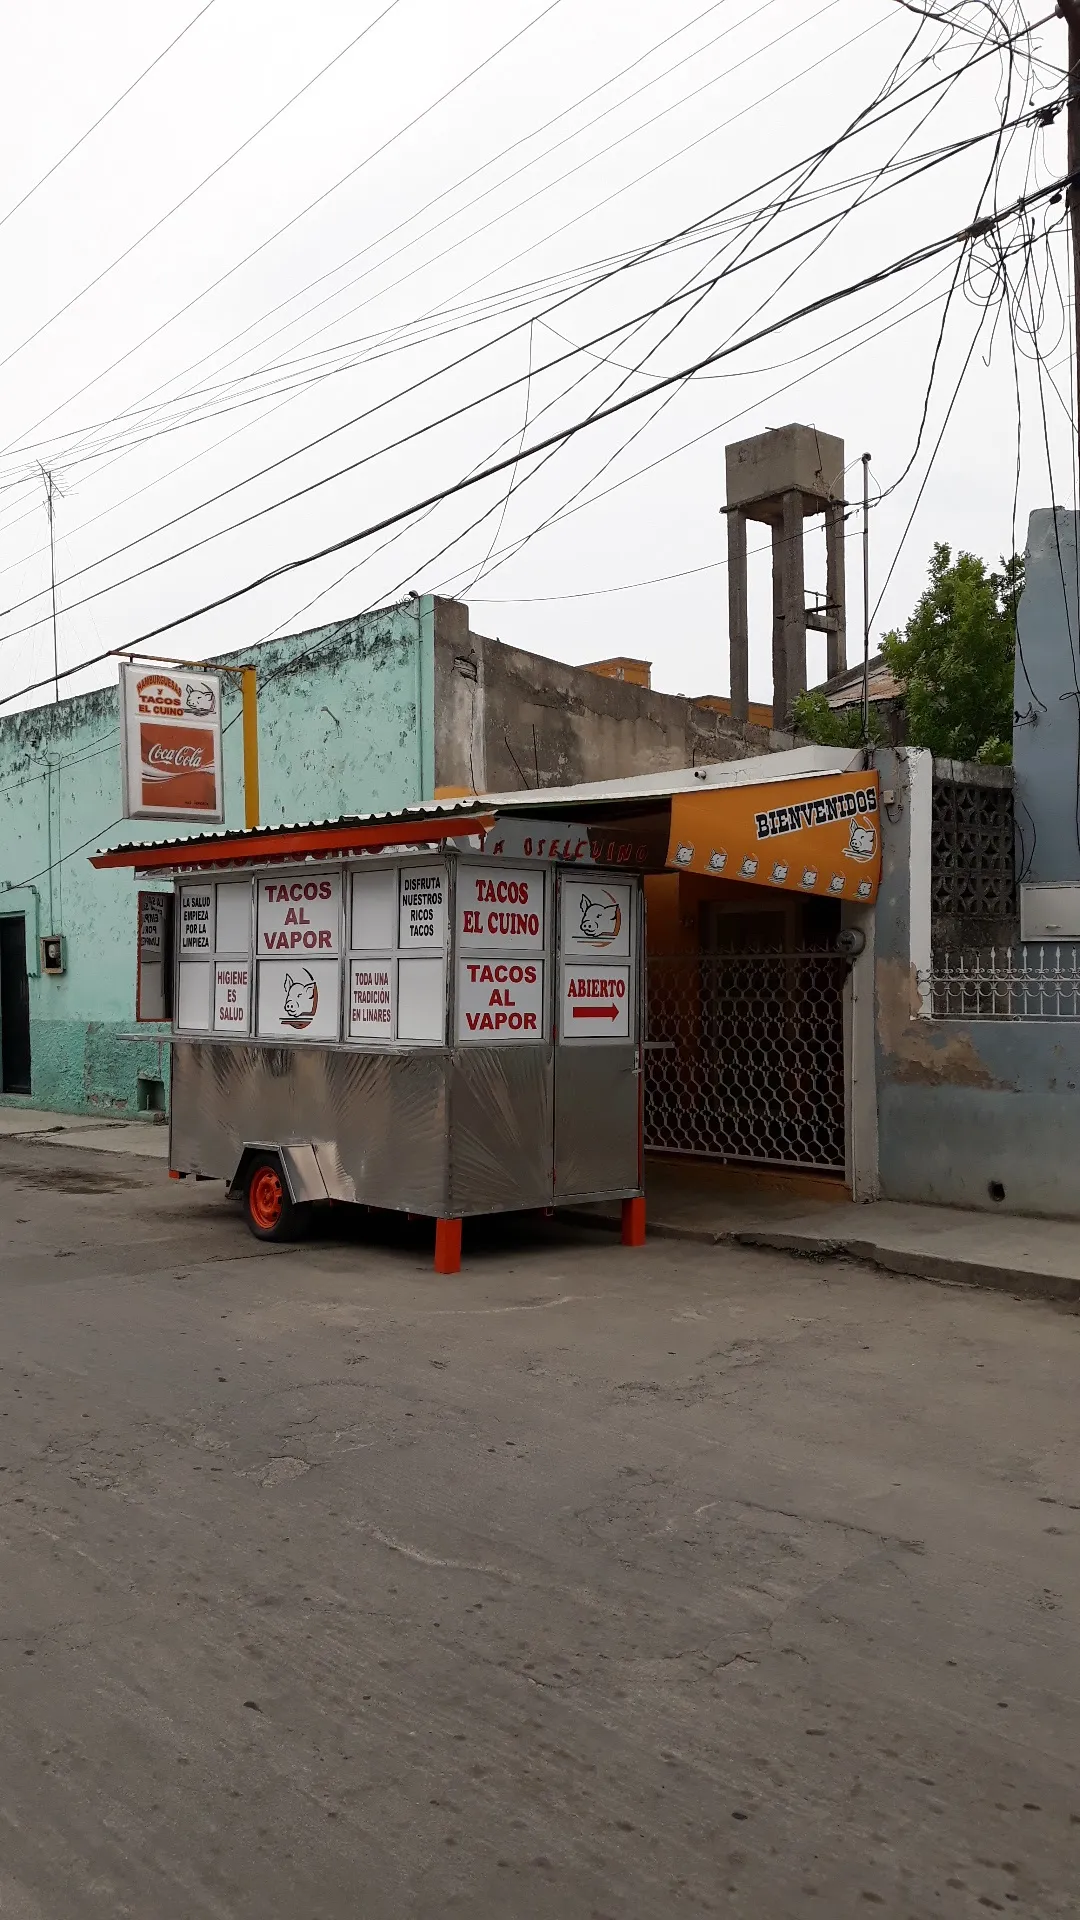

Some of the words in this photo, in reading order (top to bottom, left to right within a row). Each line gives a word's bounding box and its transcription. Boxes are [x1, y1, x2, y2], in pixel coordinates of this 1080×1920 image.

[136, 674, 182, 698] HAMBURGUESAS
[139, 695, 181, 706] TACOS
[138, 704, 151, 713] EL
[153, 706, 184, 716] CUINO
[755, 787, 877, 839] BIENVENIDOS
[404, 877, 441, 891] DISFRUTA
[265, 881, 332, 903] TACOS
[475, 879, 529, 905] TACOS
[182, 898, 190, 908] LA
[191, 897, 211, 908] SALUD
[402, 893, 443, 906] NUESTROS
[183, 911, 209, 921] EMPIEZA
[284, 907, 310, 925] AL
[410, 909, 434, 921] RICOS
[185, 924, 198, 934] POR
[198, 924, 207, 933] LA
[409, 924, 434, 937] TACOS
[463, 911, 484, 934] EL
[487, 912, 540, 936] CUINO
[182, 937, 209, 947] LIMPIEZA
[263, 930, 333, 950] VAPOR
[217, 971, 248, 984] HIGIENE
[355, 972, 373, 986] TODA
[374, 972, 389, 985] UNA
[467, 965, 537, 983] TACOS
[227, 989, 237, 1002] ES
[354, 987, 390, 1004] TRADICIÓN
[567, 979, 625, 998] ABIERTO
[488, 989, 515, 1007] AL
[219, 1007, 244, 1021] SALUD
[352, 1009, 361, 1022] EN
[362, 1008, 391, 1023] LINARES
[465, 1013, 537, 1030] VAPOR
